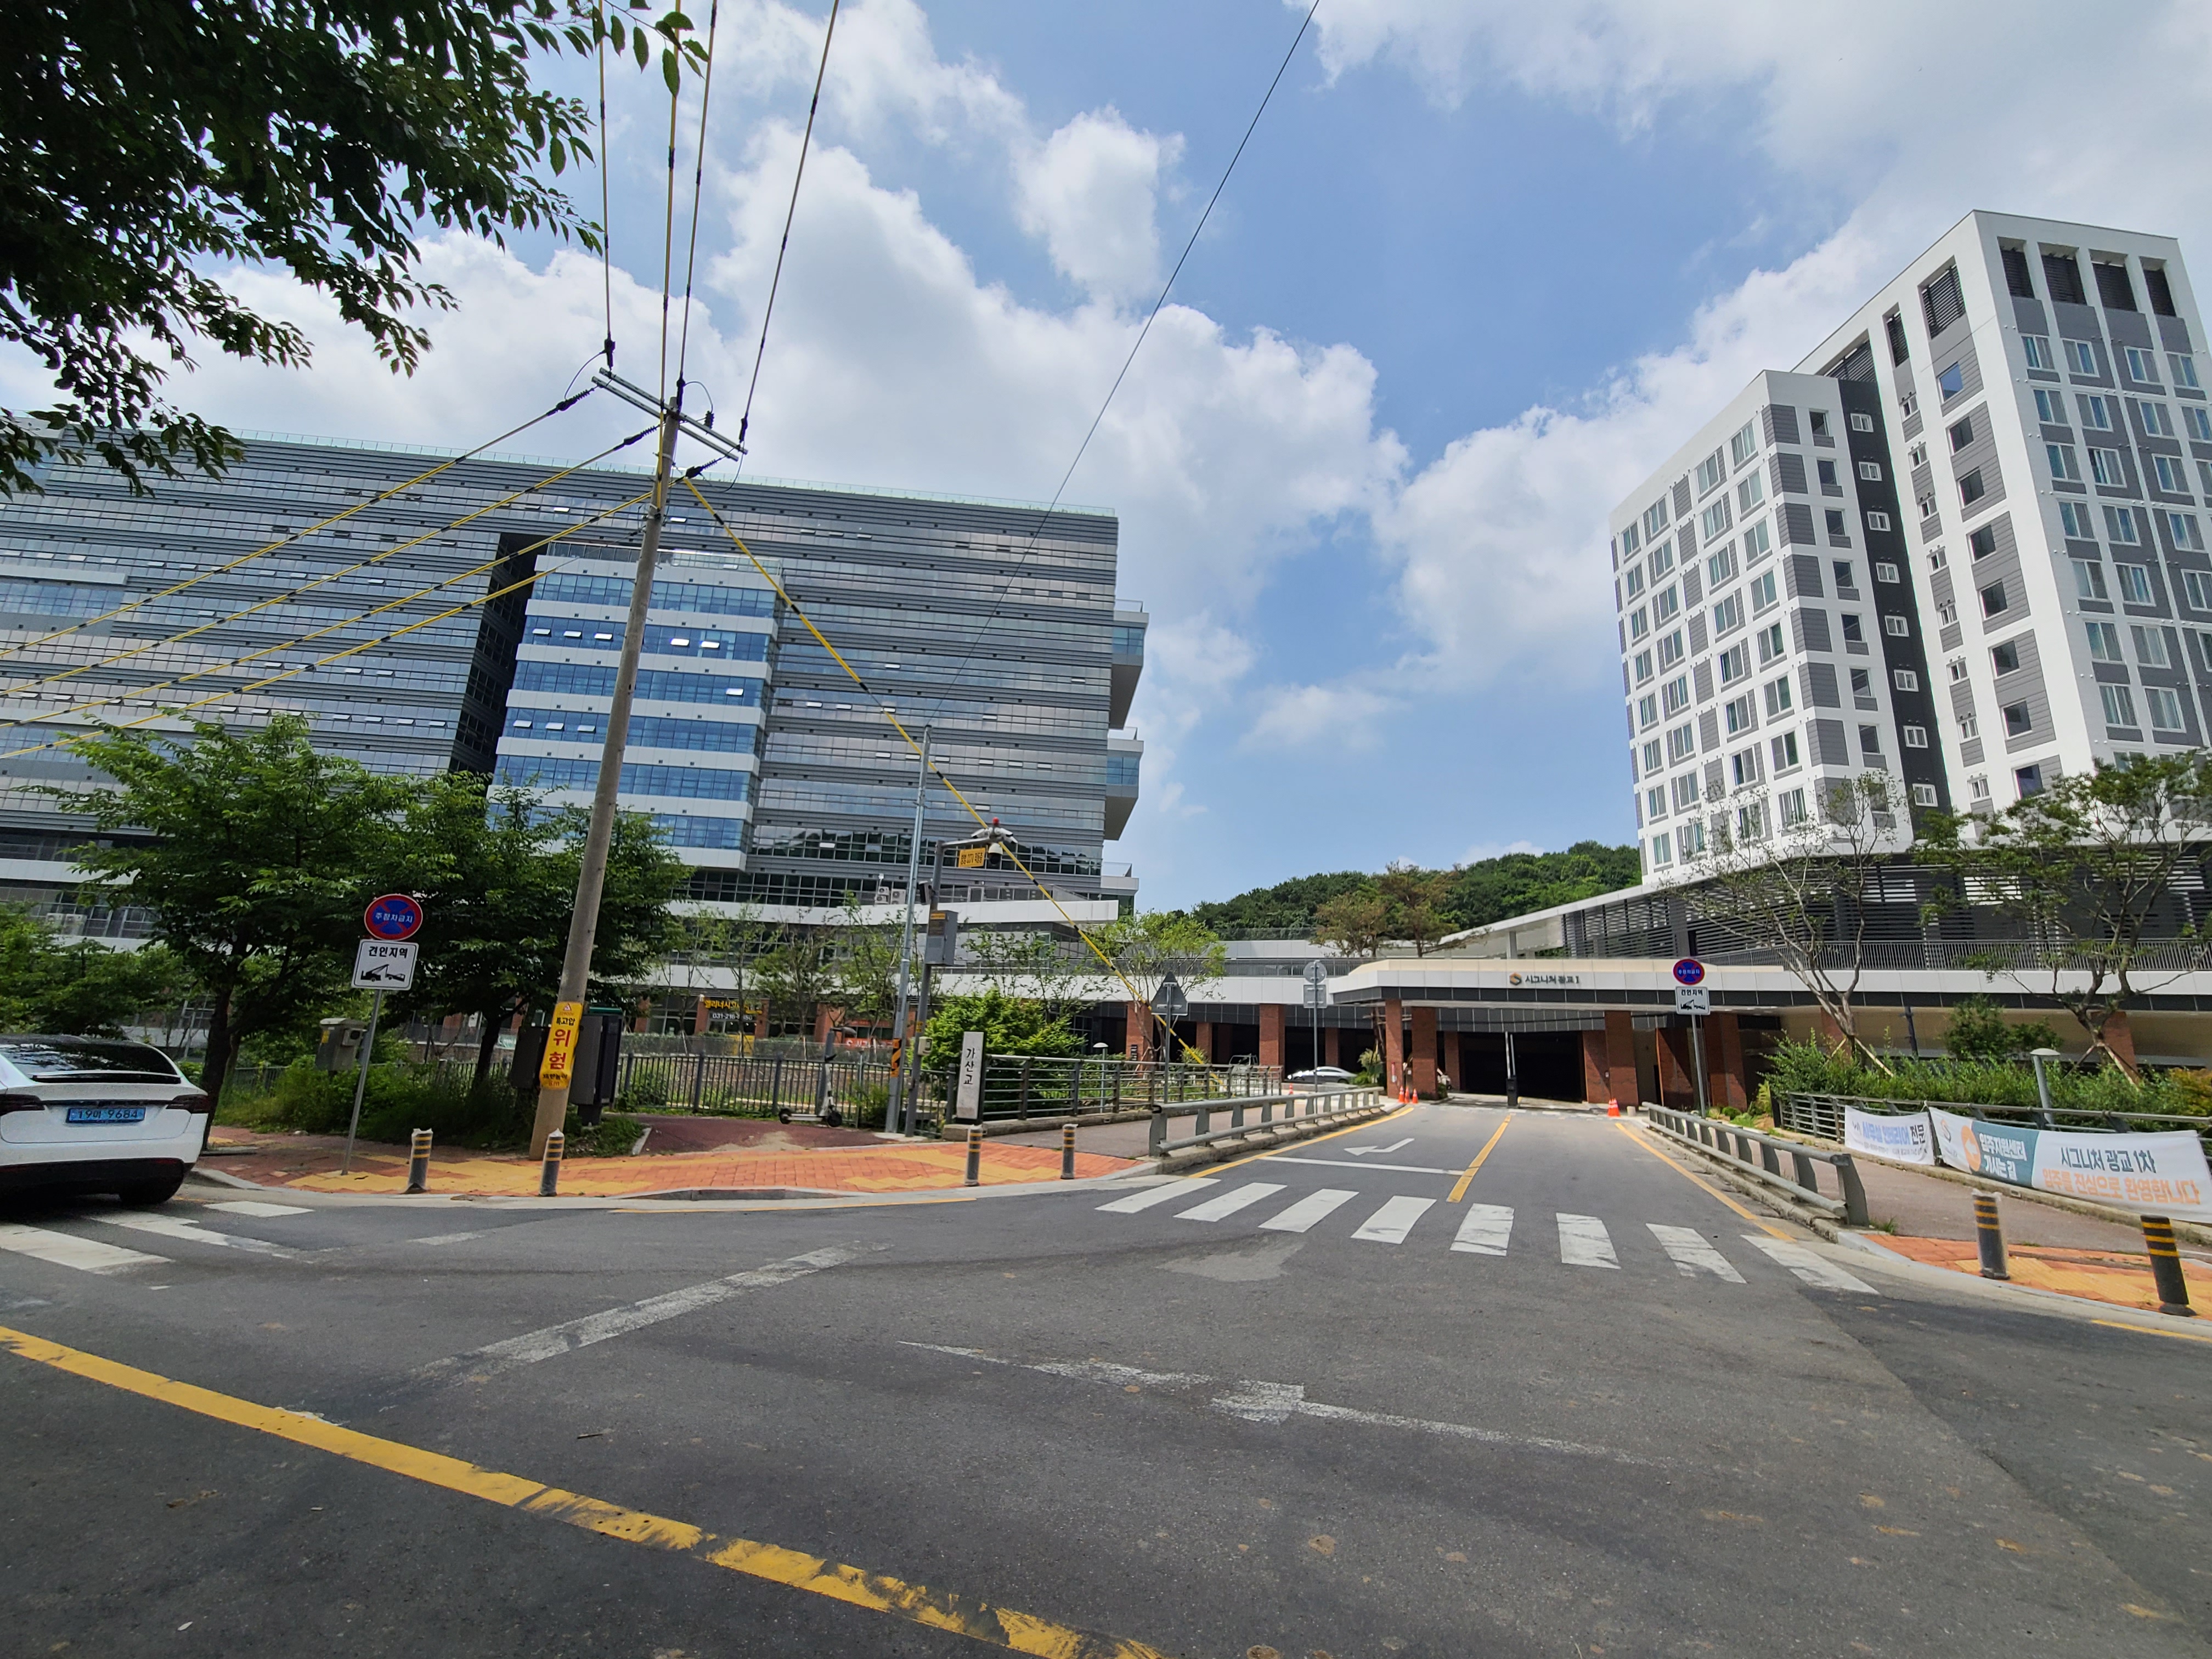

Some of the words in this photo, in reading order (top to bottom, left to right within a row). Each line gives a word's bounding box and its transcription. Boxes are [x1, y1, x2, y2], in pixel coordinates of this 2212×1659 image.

[369, 946, 408, 958] 견인지역
[1525, 974, 1556, 984] 시그니처
[556, 1017, 575, 1026] 특고압
[549, 1029, 571, 1070] 위험
[963, 1047, 975, 1085] 가산교
[108, 1109, 138, 1119] 9684
[1910, 1125, 1926, 1145] 전문
[1979, 1132, 2028, 1161] 입주지원센터
[2061, 1147, 2106, 1171] 시그니처
[2104, 1150, 2135, 1172] 광교
[2133, 1150, 2157, 1173] 1차
[2042, 1169, 2074, 1193] 입주를
[2073, 1172, 2124, 1200] 진심으로
[2124, 1177, 2201, 1205] 환영합니다
